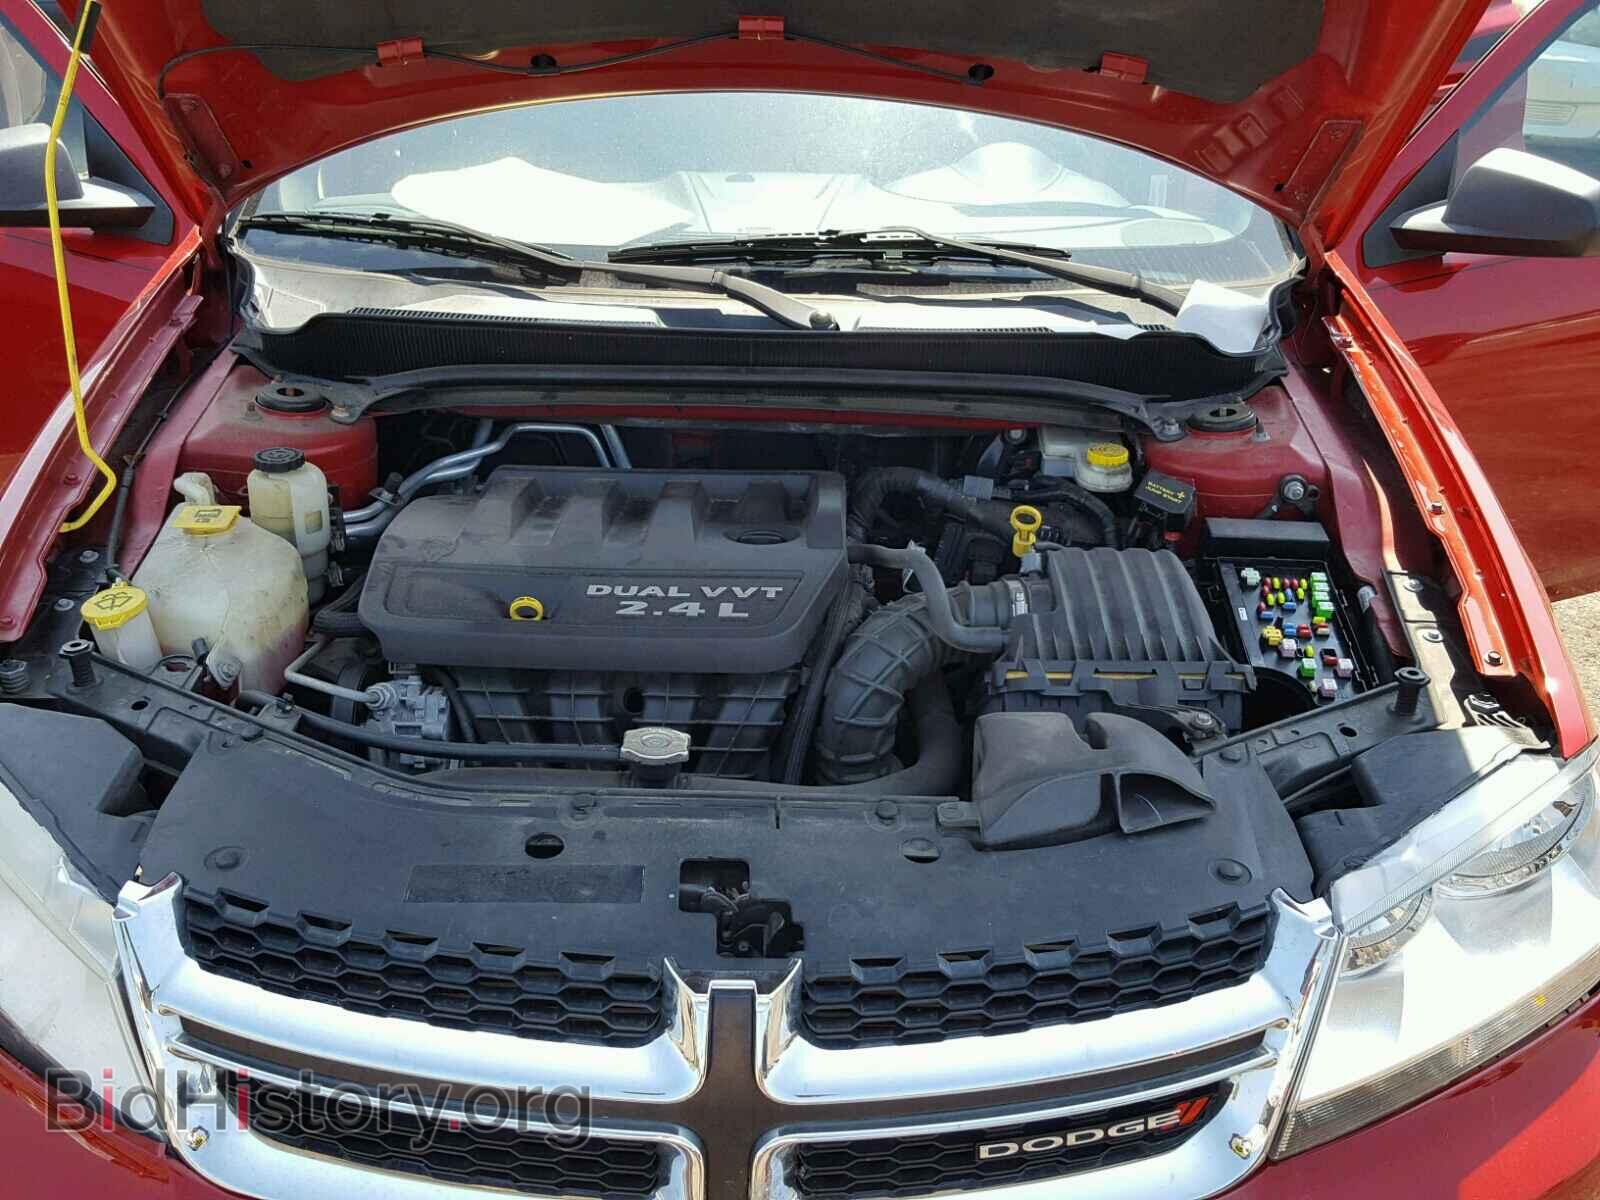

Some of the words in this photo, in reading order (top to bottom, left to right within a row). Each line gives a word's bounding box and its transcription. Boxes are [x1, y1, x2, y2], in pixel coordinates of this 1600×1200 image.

[586, 584, 690, 597] DUAL
[700, 586, 783, 598] VVT
[979, 1109, 1180, 1159] DODGE
